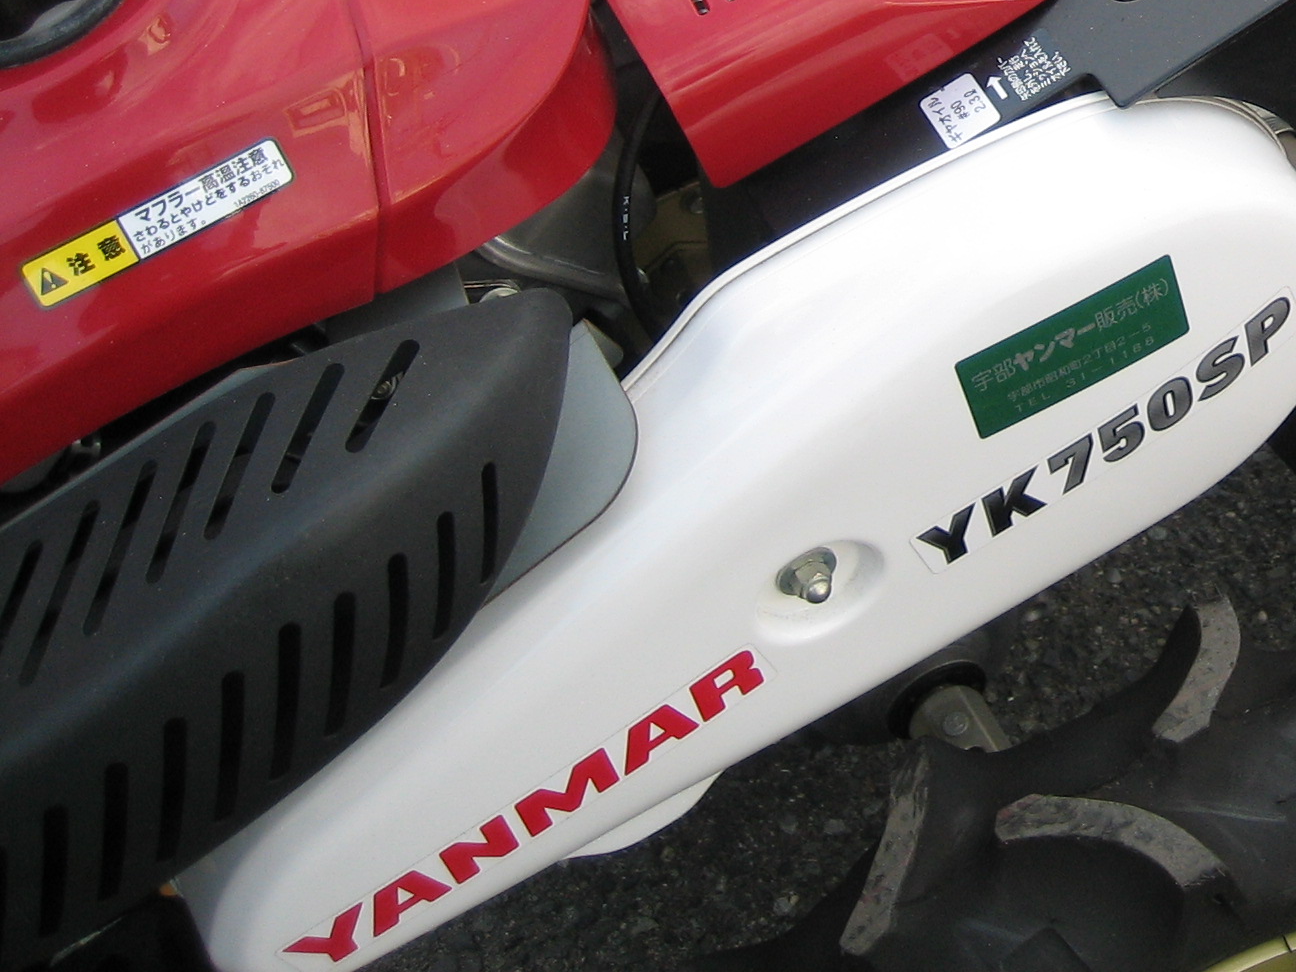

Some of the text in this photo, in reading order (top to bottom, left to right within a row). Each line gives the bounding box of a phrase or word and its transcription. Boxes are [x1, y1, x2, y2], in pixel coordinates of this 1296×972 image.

[950, 100, 970, 121] #90
[133, 158, 284, 243] さわるとやけどをするおそれ
[135, 147, 266, 221] マフラー高温注意
[140, 218, 207, 255] があります。
[916, 296, 1291, 565] YK750SP
[1013, 392, 1051, 413] TEL
[282, 649, 766, 963] YANMAR
